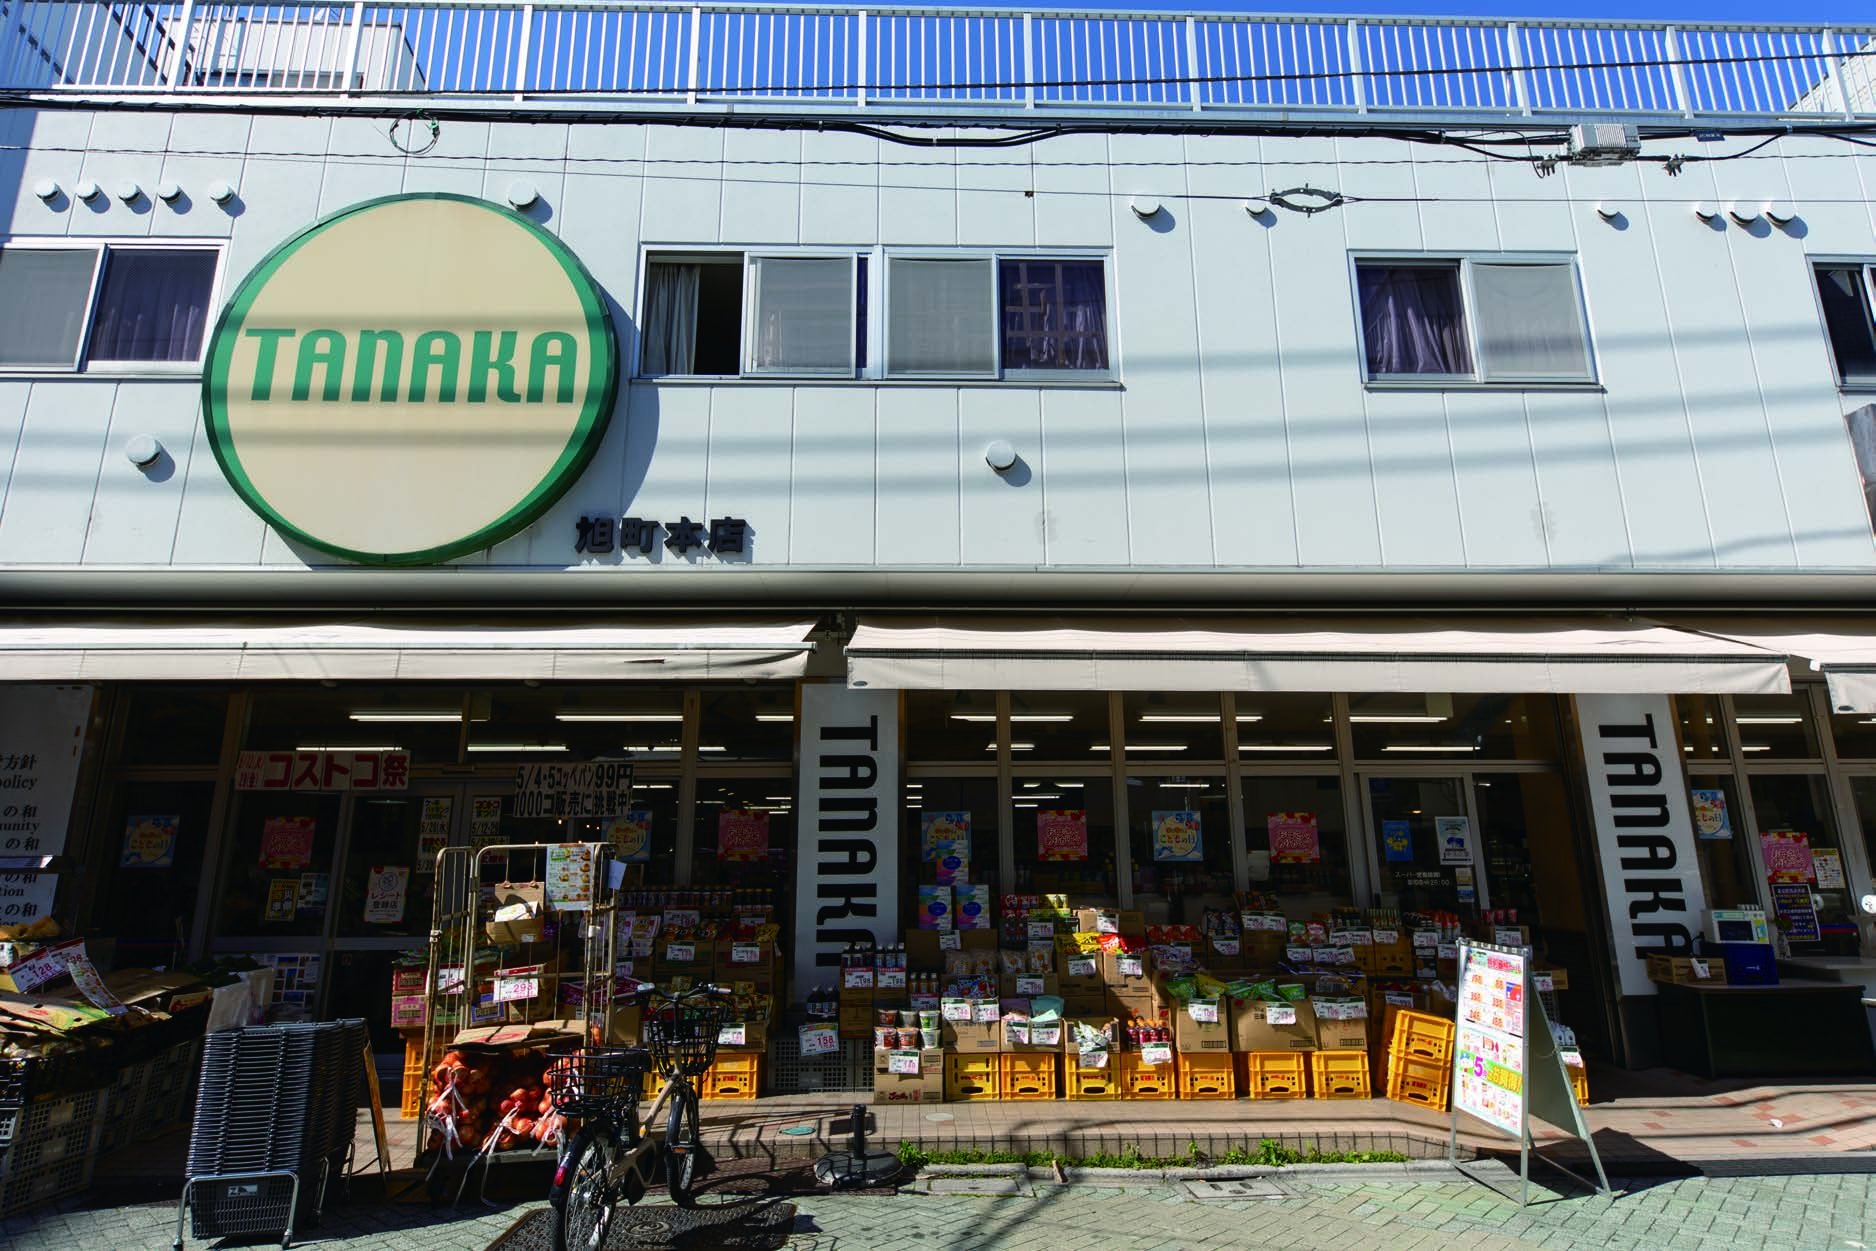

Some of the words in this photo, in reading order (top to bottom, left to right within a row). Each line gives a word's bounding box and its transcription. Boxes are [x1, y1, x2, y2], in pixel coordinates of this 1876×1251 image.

[245, 328, 578, 403] TANAKA
[575, 516, 747, 553] 旭町本店
[264, 753, 408, 788] コストコ祭
[1598, 713, 1692, 960] TANAKA
[32, 963, 53, 978] 128
[513, 983, 533, 993] 298
